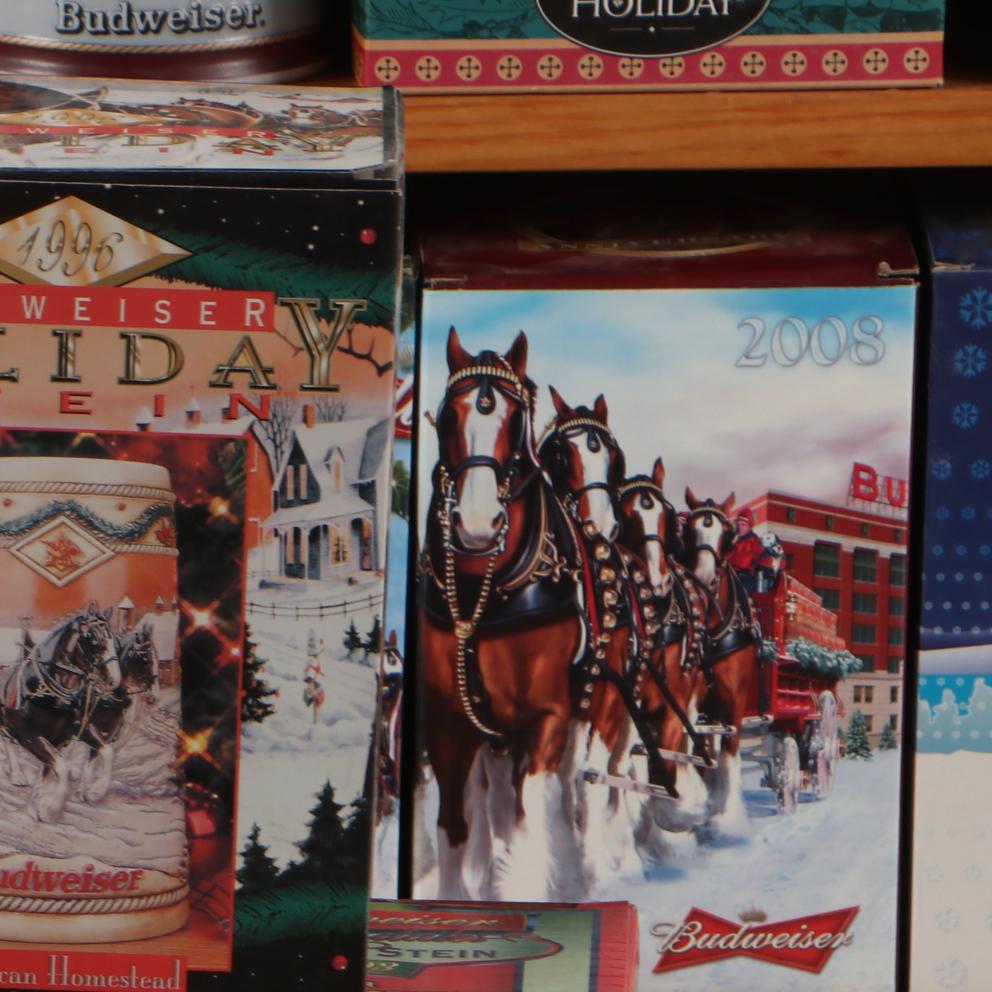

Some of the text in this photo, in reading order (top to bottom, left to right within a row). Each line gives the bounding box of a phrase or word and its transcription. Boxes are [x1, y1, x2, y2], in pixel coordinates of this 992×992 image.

[17, 218, 128, 278] 1996
[734, 315, 887, 368] 2008
[376, 947, 497, 959] STEIN
[650, 920, 856, 954] Budweiser
[47, 954, 182, 991] Homestead
